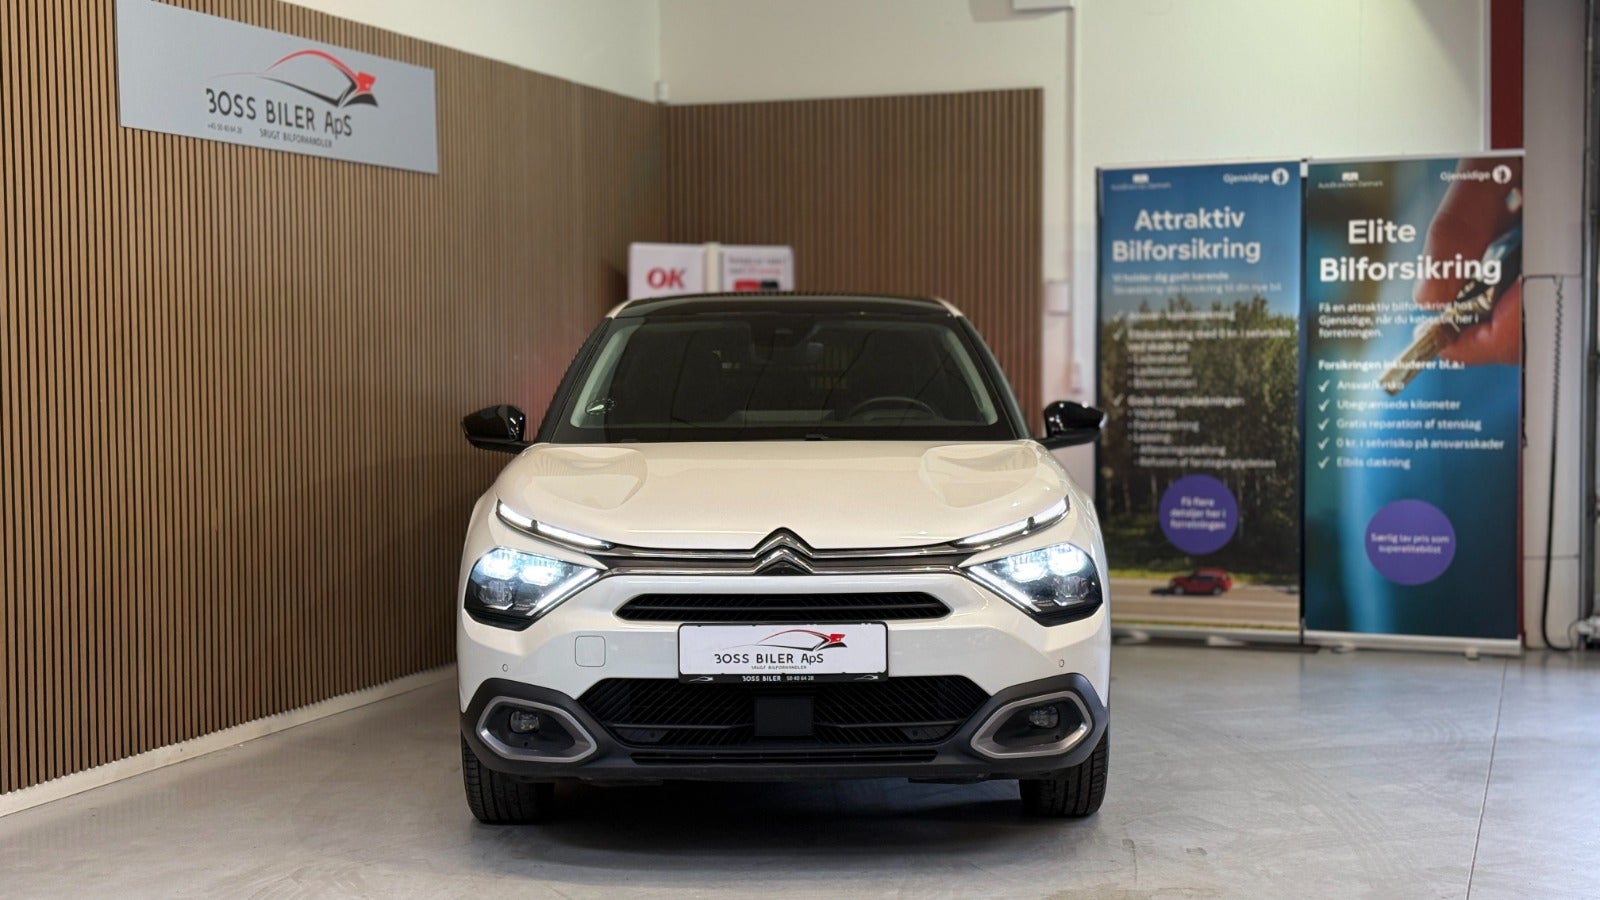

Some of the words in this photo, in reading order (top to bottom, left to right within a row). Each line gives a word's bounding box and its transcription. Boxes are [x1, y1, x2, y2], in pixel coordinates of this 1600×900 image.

[266, 99, 316, 131] BILER
[324, 111, 353, 140] ApS
[1223, 173, 1270, 184] Gjensidige
[1440, 171, 1490, 183] Gjensidige
[1134, 206, 1245, 231] Attraktiv
[1348, 218, 1417, 244] Elite
[1112, 238, 1261, 264] Bilforsikring
[1319, 253, 1502, 285] Bilforsikring
[646, 267, 687, 289] OK
[1319, 302, 1331, 312] Få
[1332, 304, 1345, 312] en
[1347, 301, 1391, 312] attraktiv
[1375, 314, 1392, 324] når
[1394, 314, 1408, 324] du
[1318, 359, 1382, 371] Forsikringen
[1410, 399, 1461, 410] kilometer
[1336, 419, 1367, 429] Gratis
[1369, 419, 1423, 430] reparation
[1424, 419, 1435, 429] af
[1437, 419, 1482, 431] stenslag
[1336, 439, 1344, 448] 0
[1365, 438, 1413, 448] selvrisiko
[1415, 438, 1428, 450] på
[1430, 438, 1505, 450] ansvarsskader
[1431, 535, 1450, 544] som
[756, 653, 794, 664] BILER
[801, 653, 824, 666] ApS
